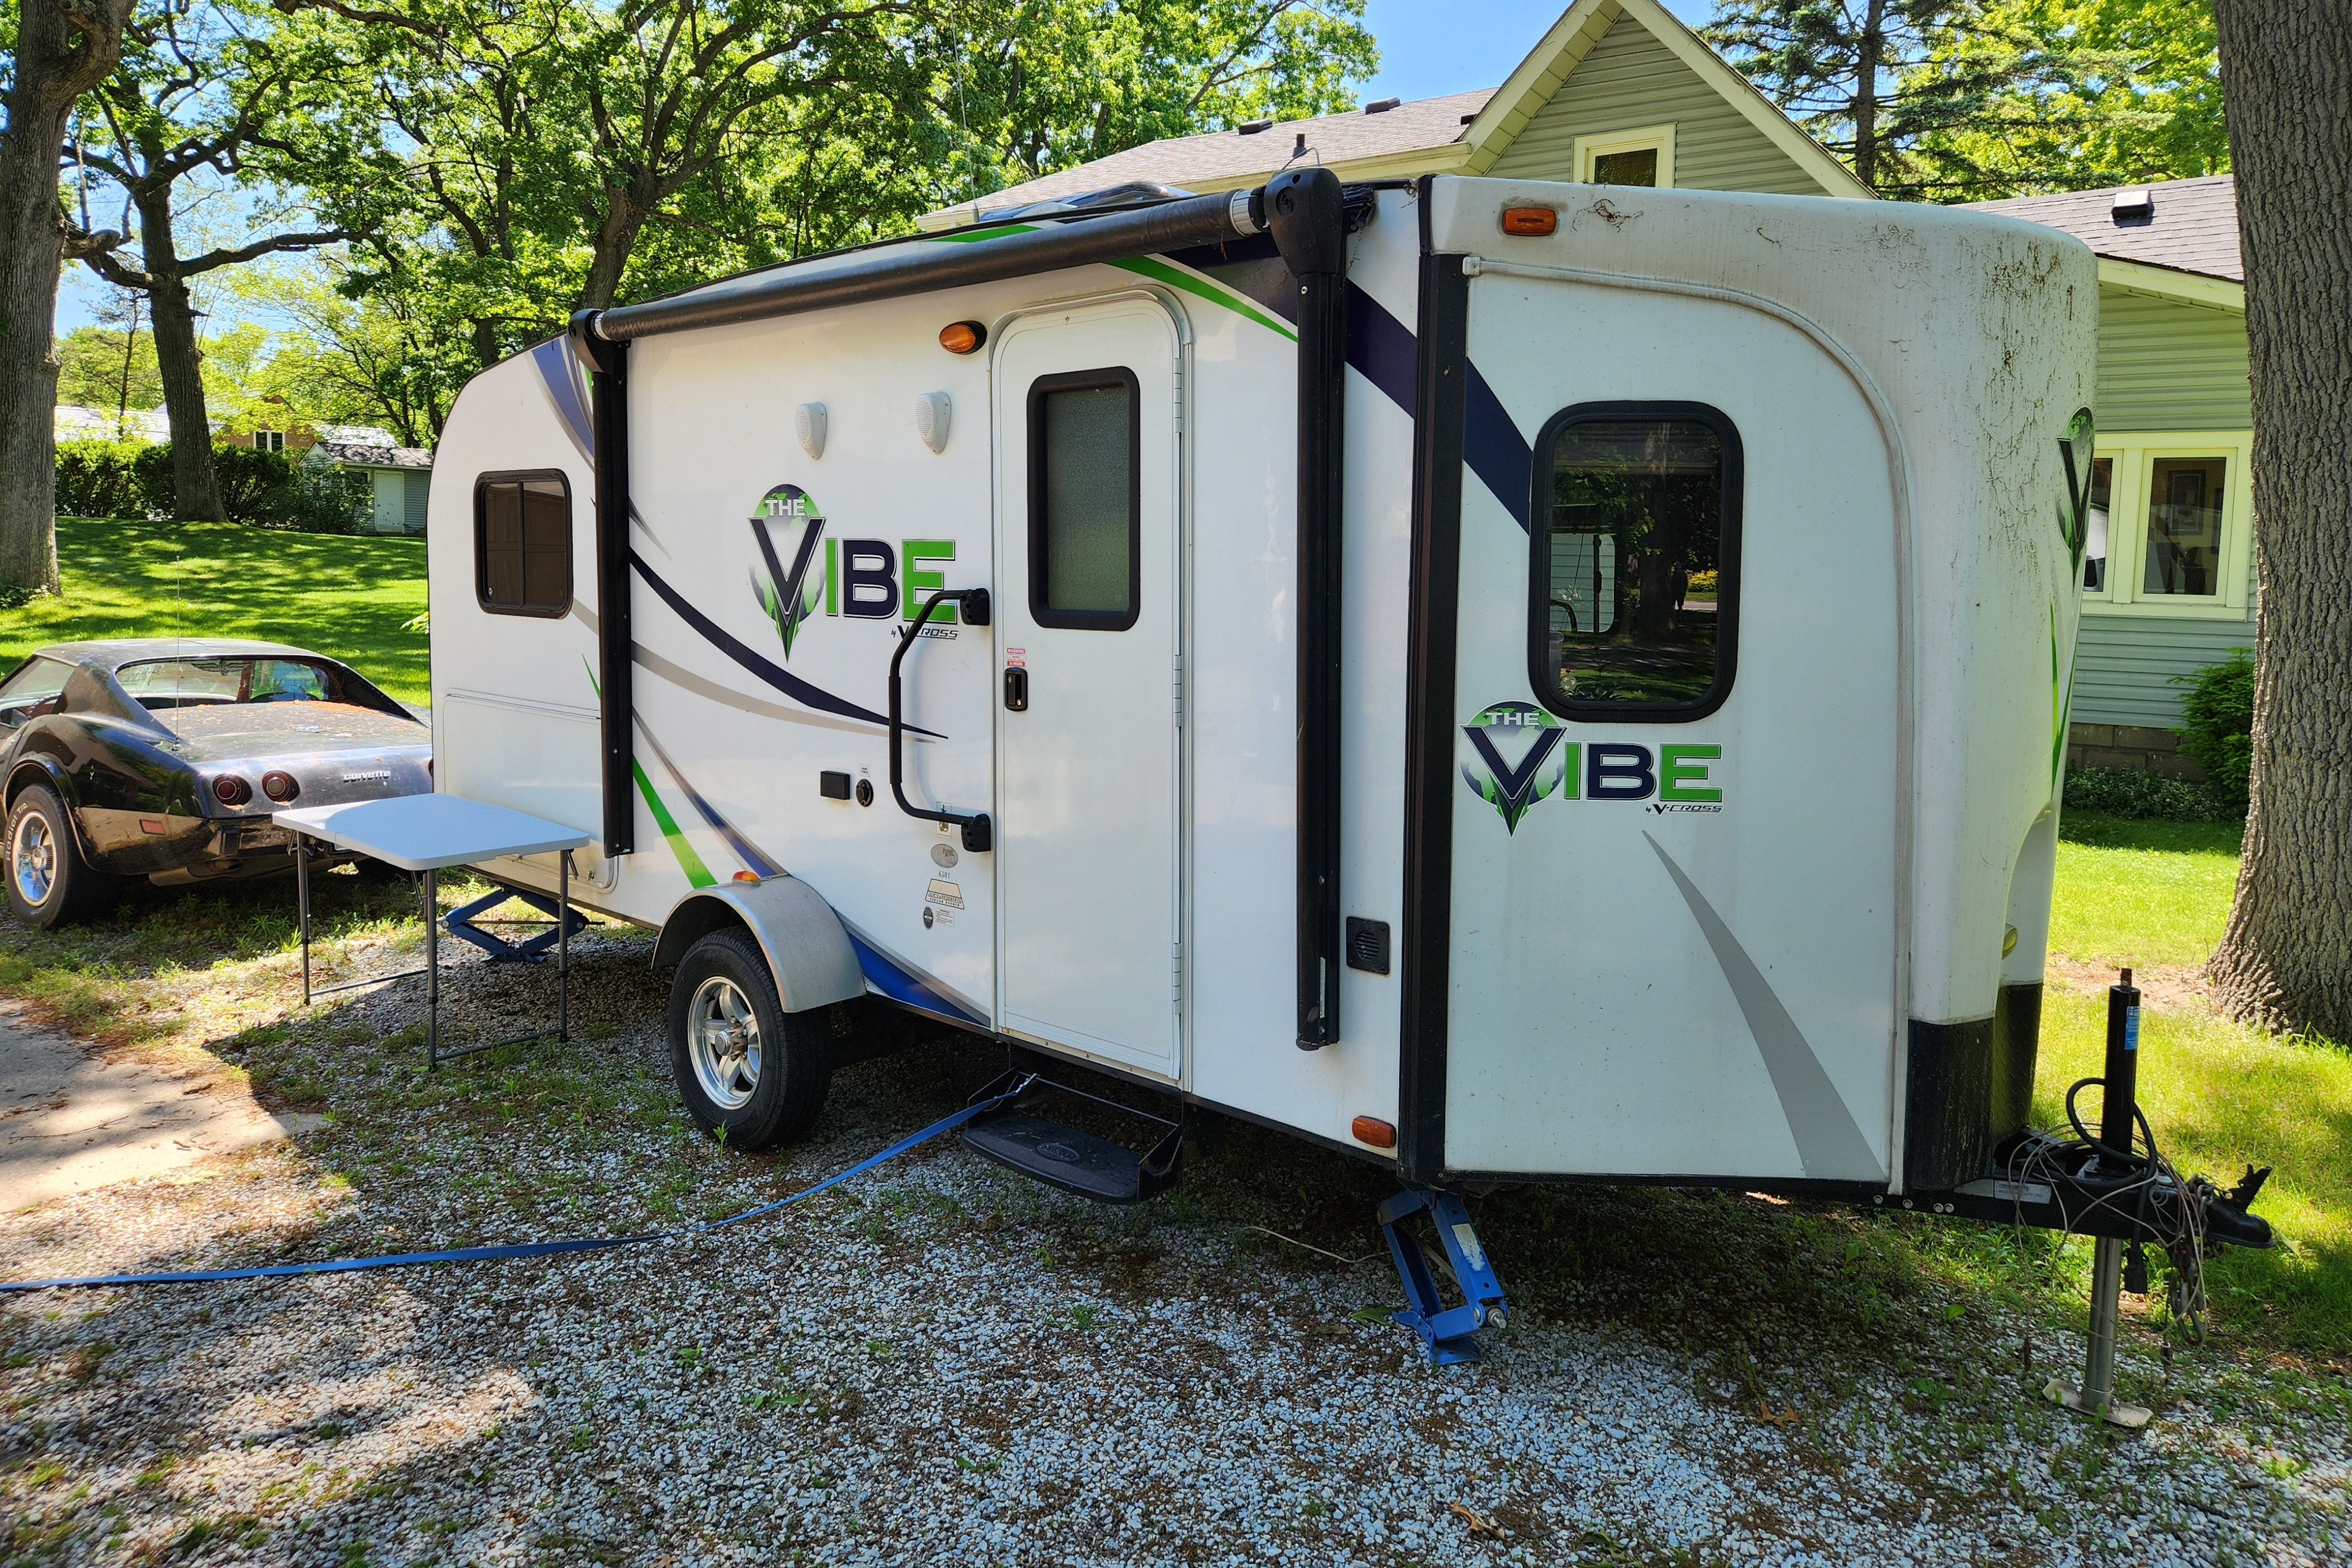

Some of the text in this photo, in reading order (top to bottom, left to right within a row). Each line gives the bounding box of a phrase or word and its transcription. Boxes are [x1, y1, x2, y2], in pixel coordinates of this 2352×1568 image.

[765, 498, 806, 517] THE
[747, 517, 958, 625] VIBE
[1485, 712, 1540, 727] THE
[1459, 724, 1722, 803] VIBE
[1652, 804, 1724, 815] V-CROSS
[6, 802, 28, 861] Radial T/A
